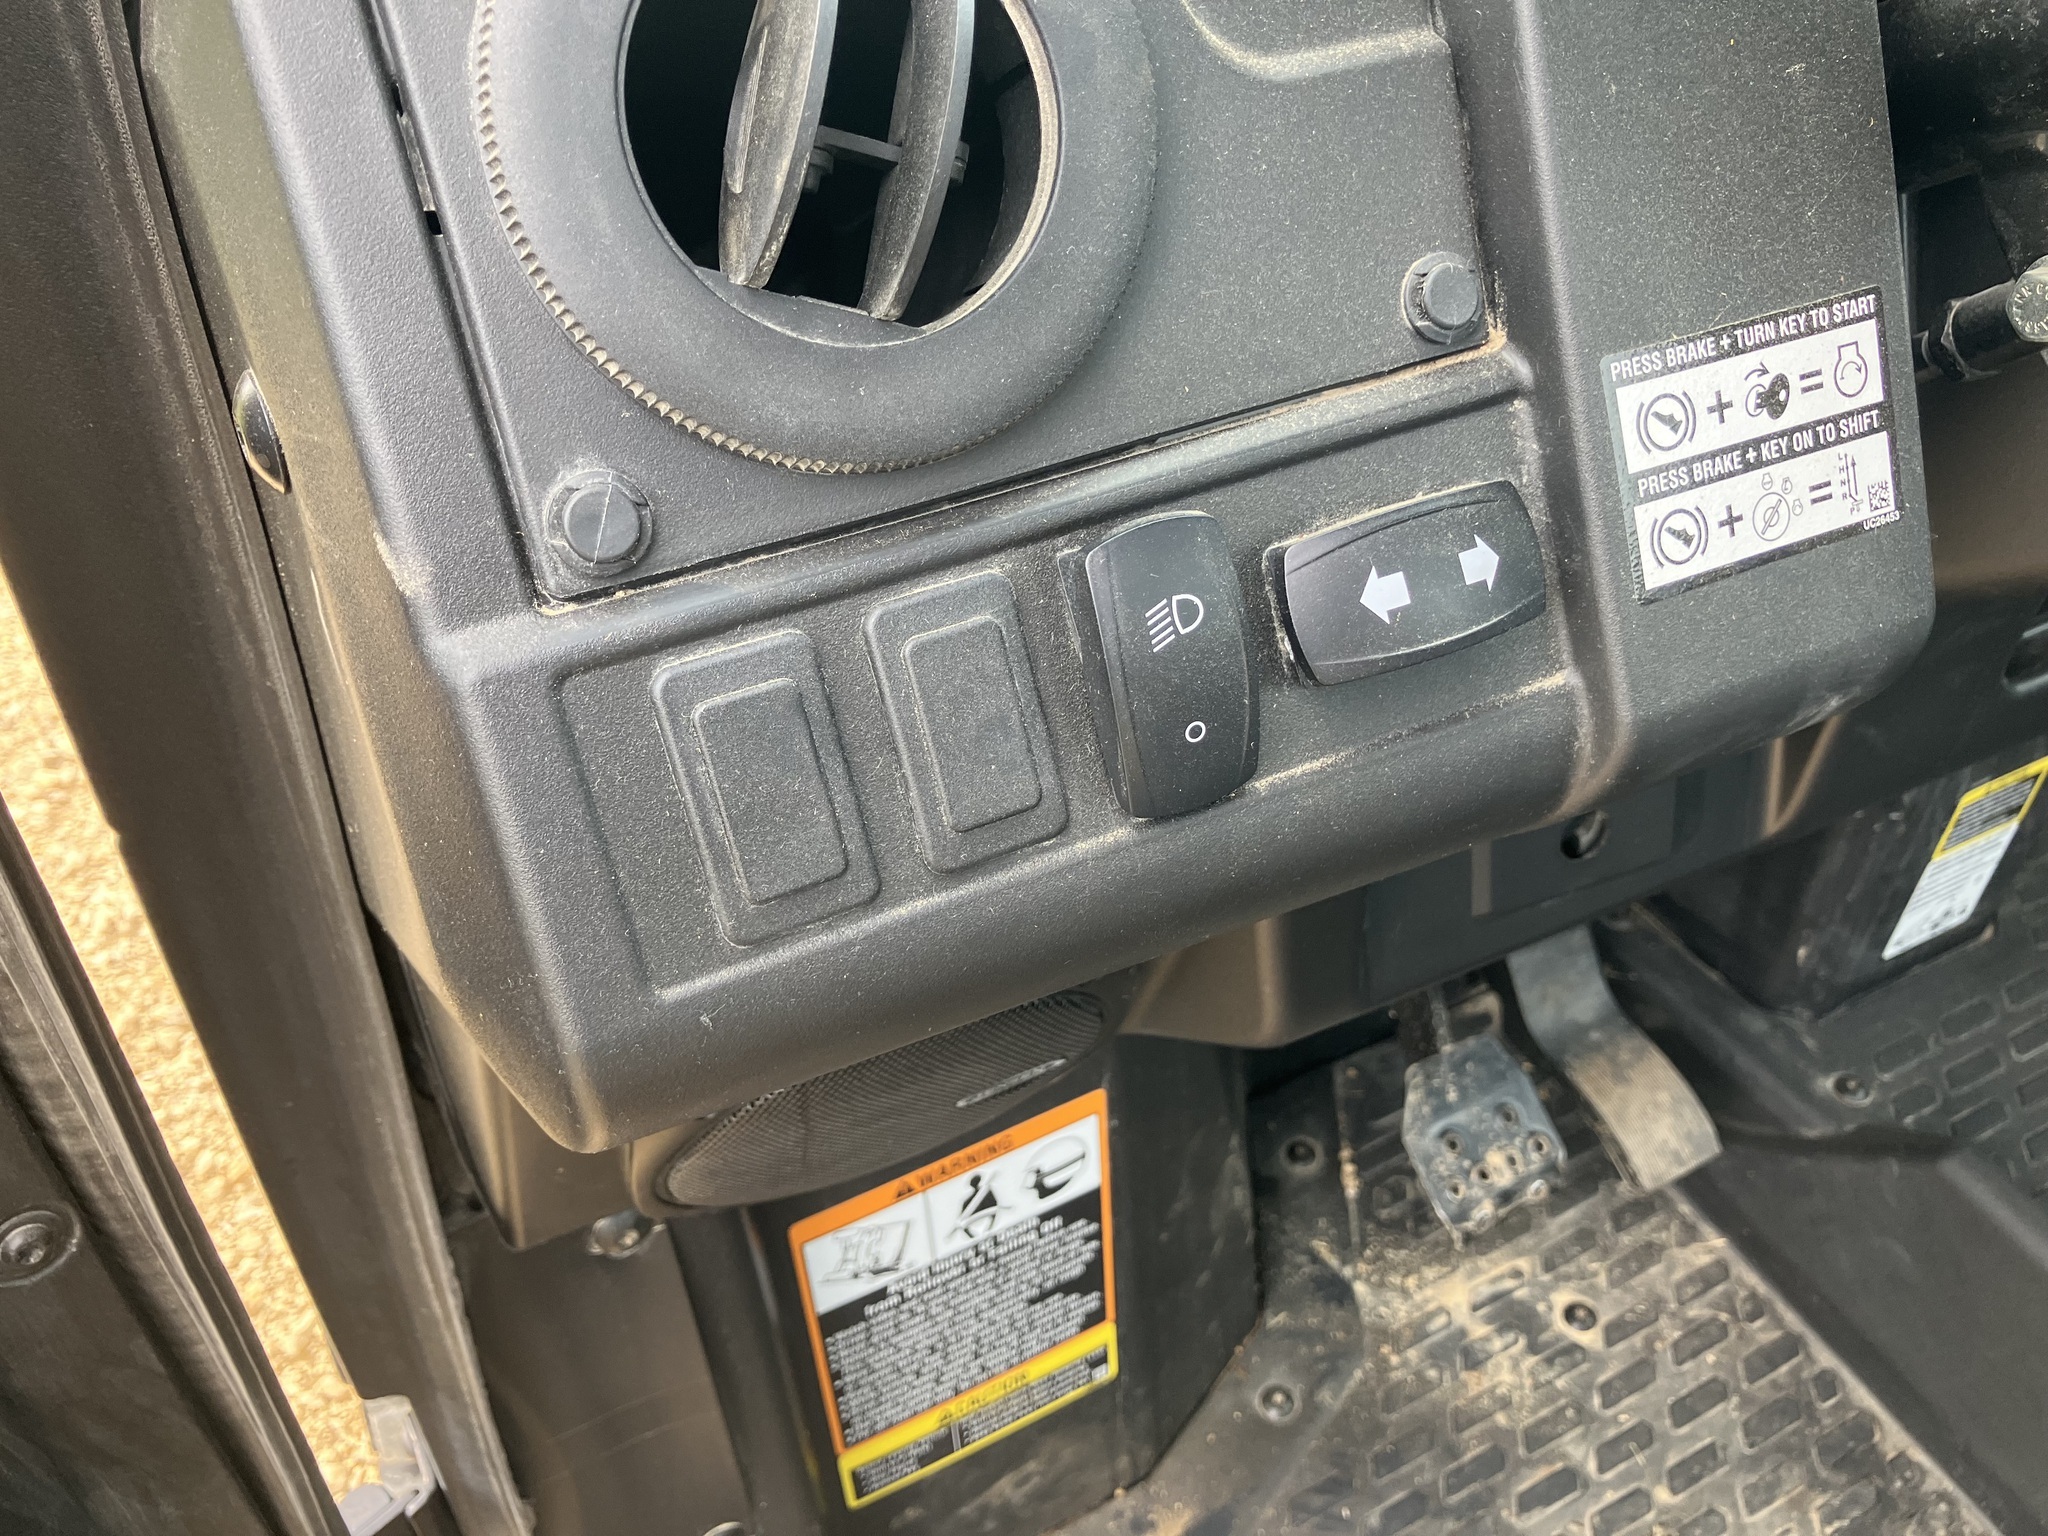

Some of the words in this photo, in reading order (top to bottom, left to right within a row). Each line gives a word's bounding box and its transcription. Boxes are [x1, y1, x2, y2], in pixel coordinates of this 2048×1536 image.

[1610, 357, 1663, 382] PRESS
[1666, 337, 1716, 366] BRAKE
[1735, 321, 1776, 349] TURN
[1778, 313, 1808, 339] KEY
[1808, 308, 1829, 327] TO
[1832, 294, 1876, 320] START
[1637, 471, 1690, 498] PRESS
[1692, 451, 1742, 482] BRAKE
[1761, 437, 1789, 462] KEY
[1792, 431, 1814, 452] ON
[1816, 424, 1836, 445] TO
[1839, 410, 1879, 438] SHIFT
[1863, 510, 1900, 531] UC26453
[917, 1133, 1015, 1187] WARNING
